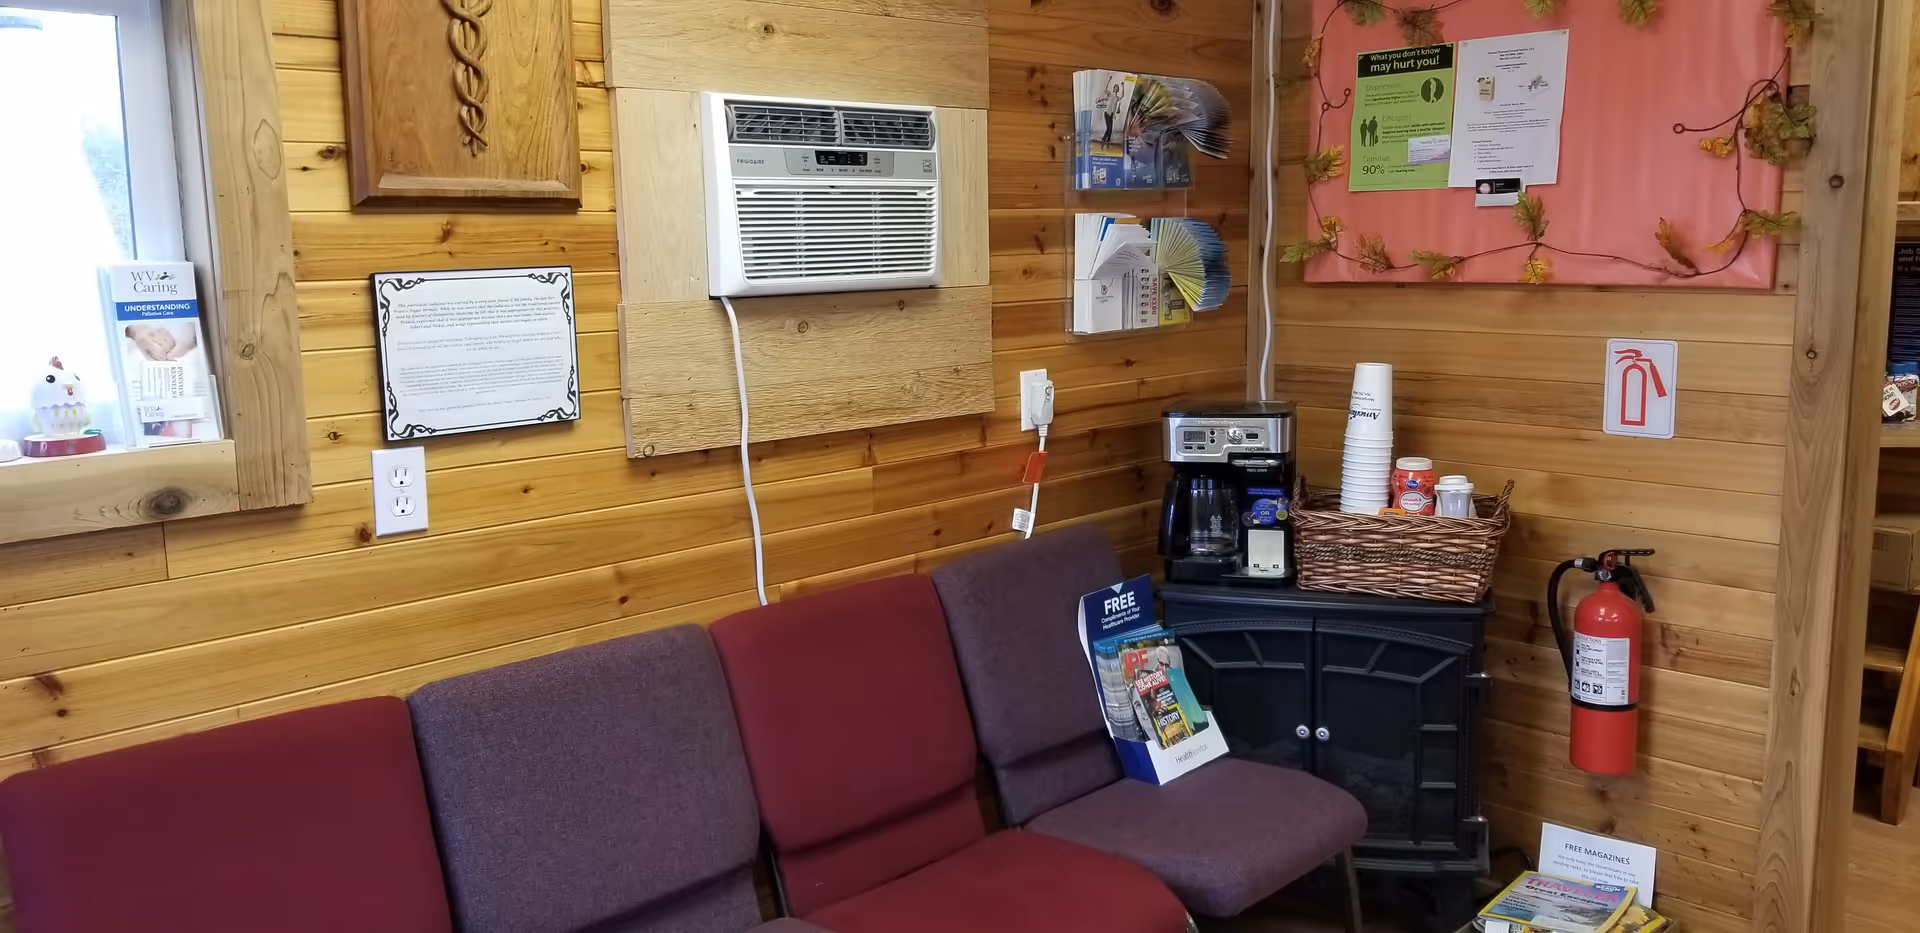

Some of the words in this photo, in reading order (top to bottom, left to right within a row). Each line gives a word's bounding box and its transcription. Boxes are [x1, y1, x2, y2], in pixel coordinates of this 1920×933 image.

[1370, 53, 1388, 61] What
[1389, 53, 1401, 61] you
[1402, 49, 1420, 57] don't
[1370, 63, 1392, 73] may
[1393, 60, 1415, 70] hurt
[1416, 55, 1440, 69] you!
[1362, 164, 1385, 175] 90%
[131, 270, 155, 282] WV
[133, 282, 177, 295] Caring
[124, 303, 191, 312] UNDERSTANDING
[1104, 591, 1136, 615] FREE
[1101, 611, 1126, 624] Compliments
[1102, 618, 1124, 631] Healthcare
[1124, 613, 1140, 622] Provider
[1123, 649, 1149, 678] IPF
[1135, 679, 1144, 687] SEE
[1143, 670, 1164, 684] HISTORY
[1138, 683, 1152, 692] COME
[1157, 711, 1180, 728] HISTORY
[1565, 843, 1583, 854] FREE
[1584, 848, 1631, 865] MAGAZINES
[1589, 868, 1603, 876] please
[1525, 885, 1559, 896] Great
[1559, 892, 1609, 907] Escapes
[1527, 877, 1619, 903] TRAVELER
